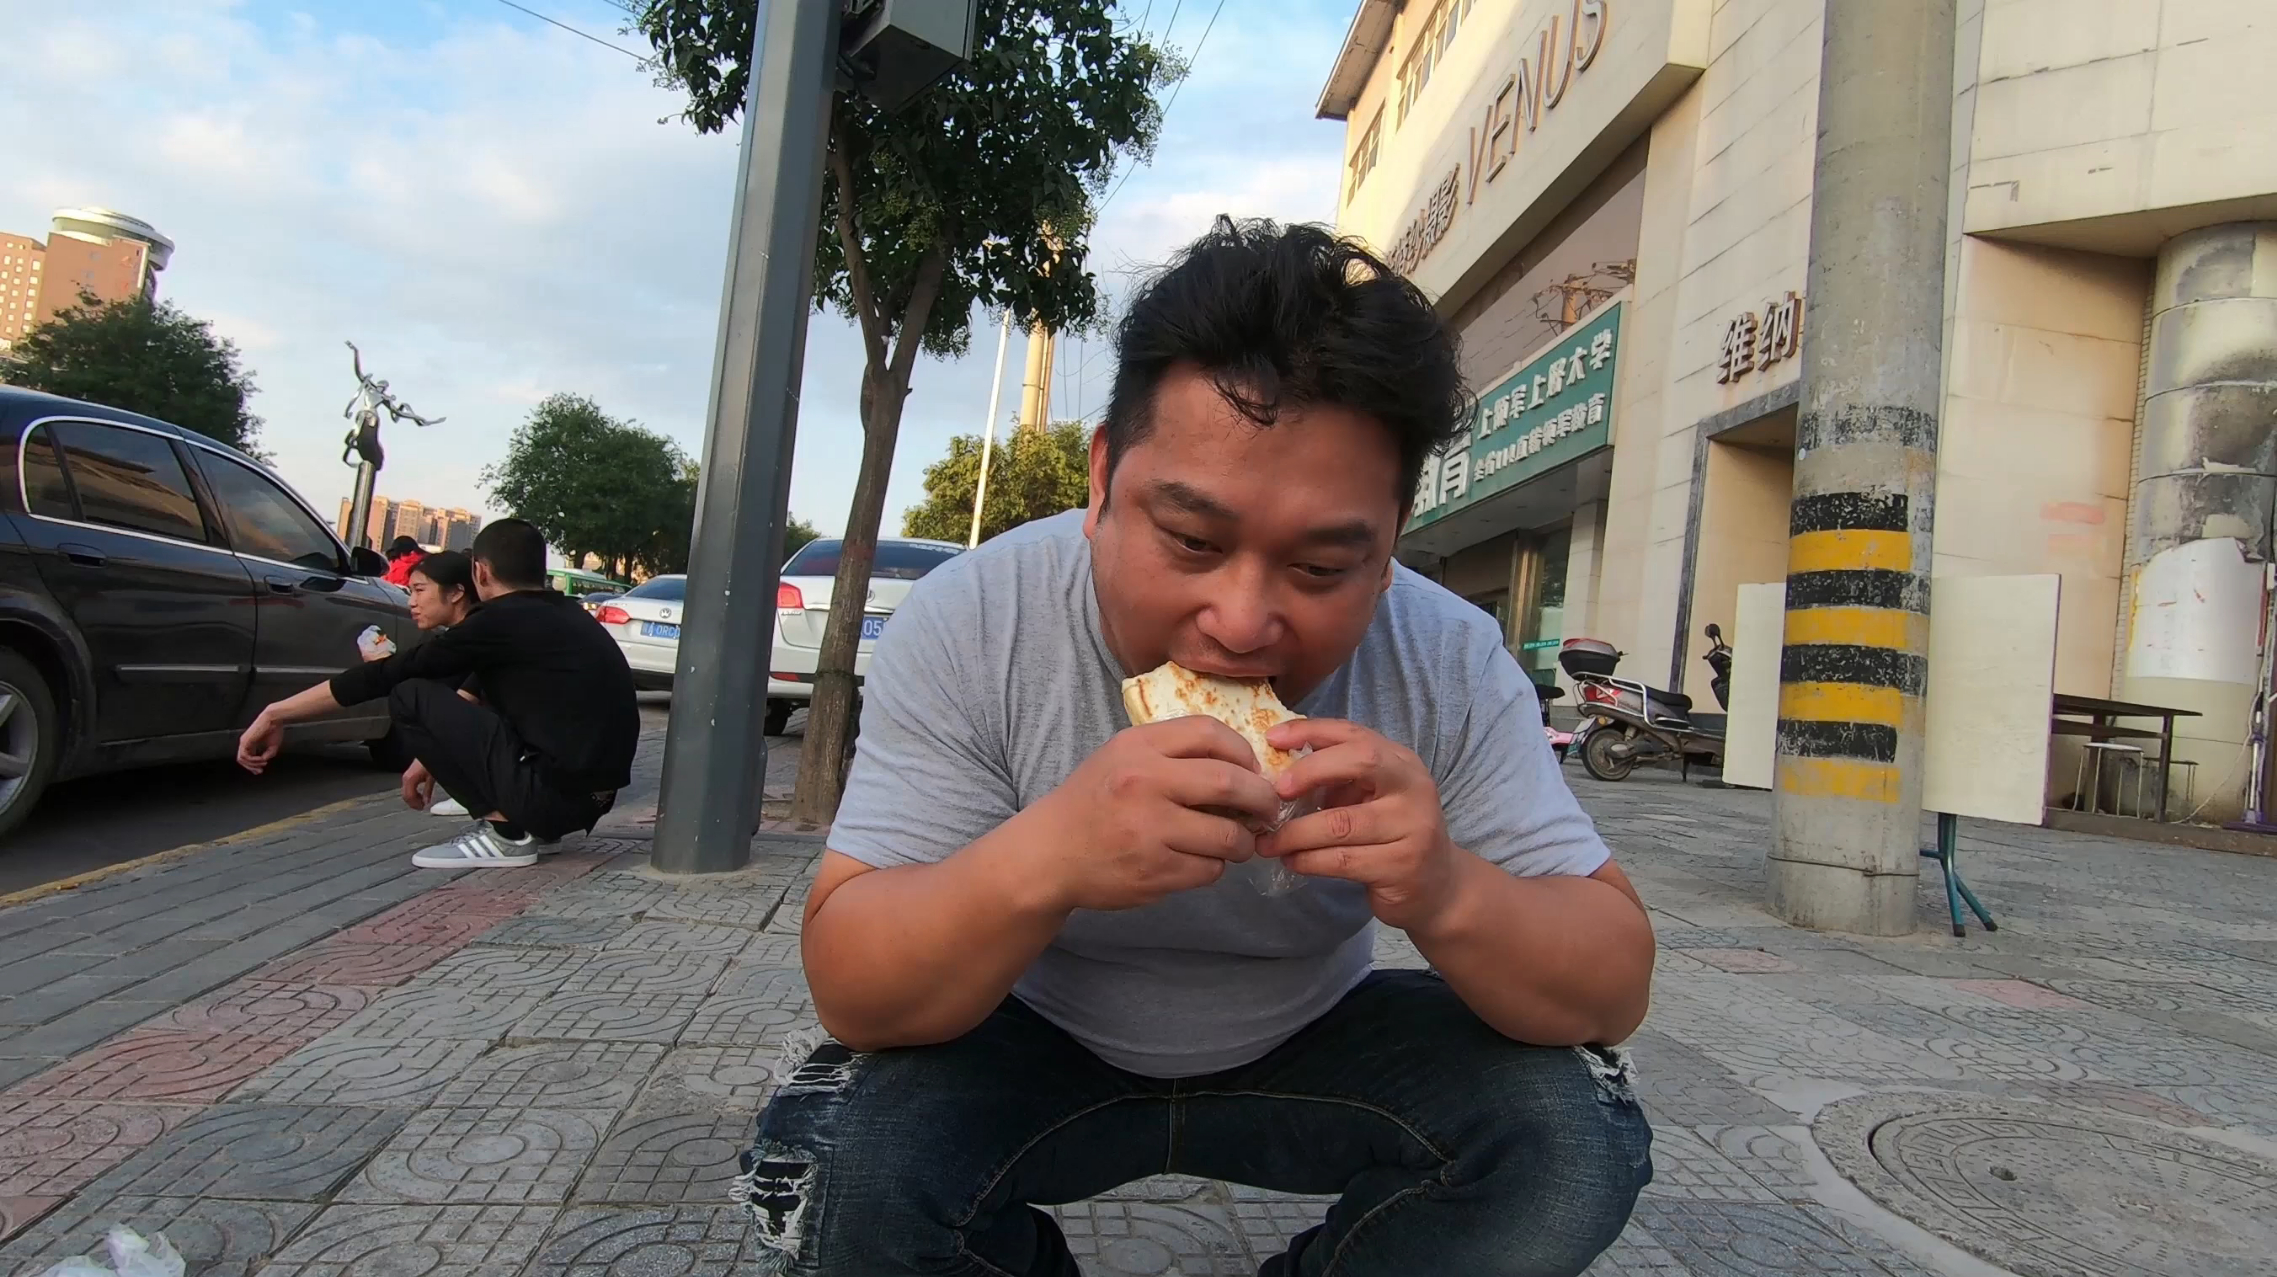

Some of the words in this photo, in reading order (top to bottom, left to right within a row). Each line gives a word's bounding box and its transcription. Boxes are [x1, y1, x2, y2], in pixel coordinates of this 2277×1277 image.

[1466, 0, 1607, 206] VENUS
[1717, 291, 1805, 384] 维纳
[863, 619, 886, 636] 05
